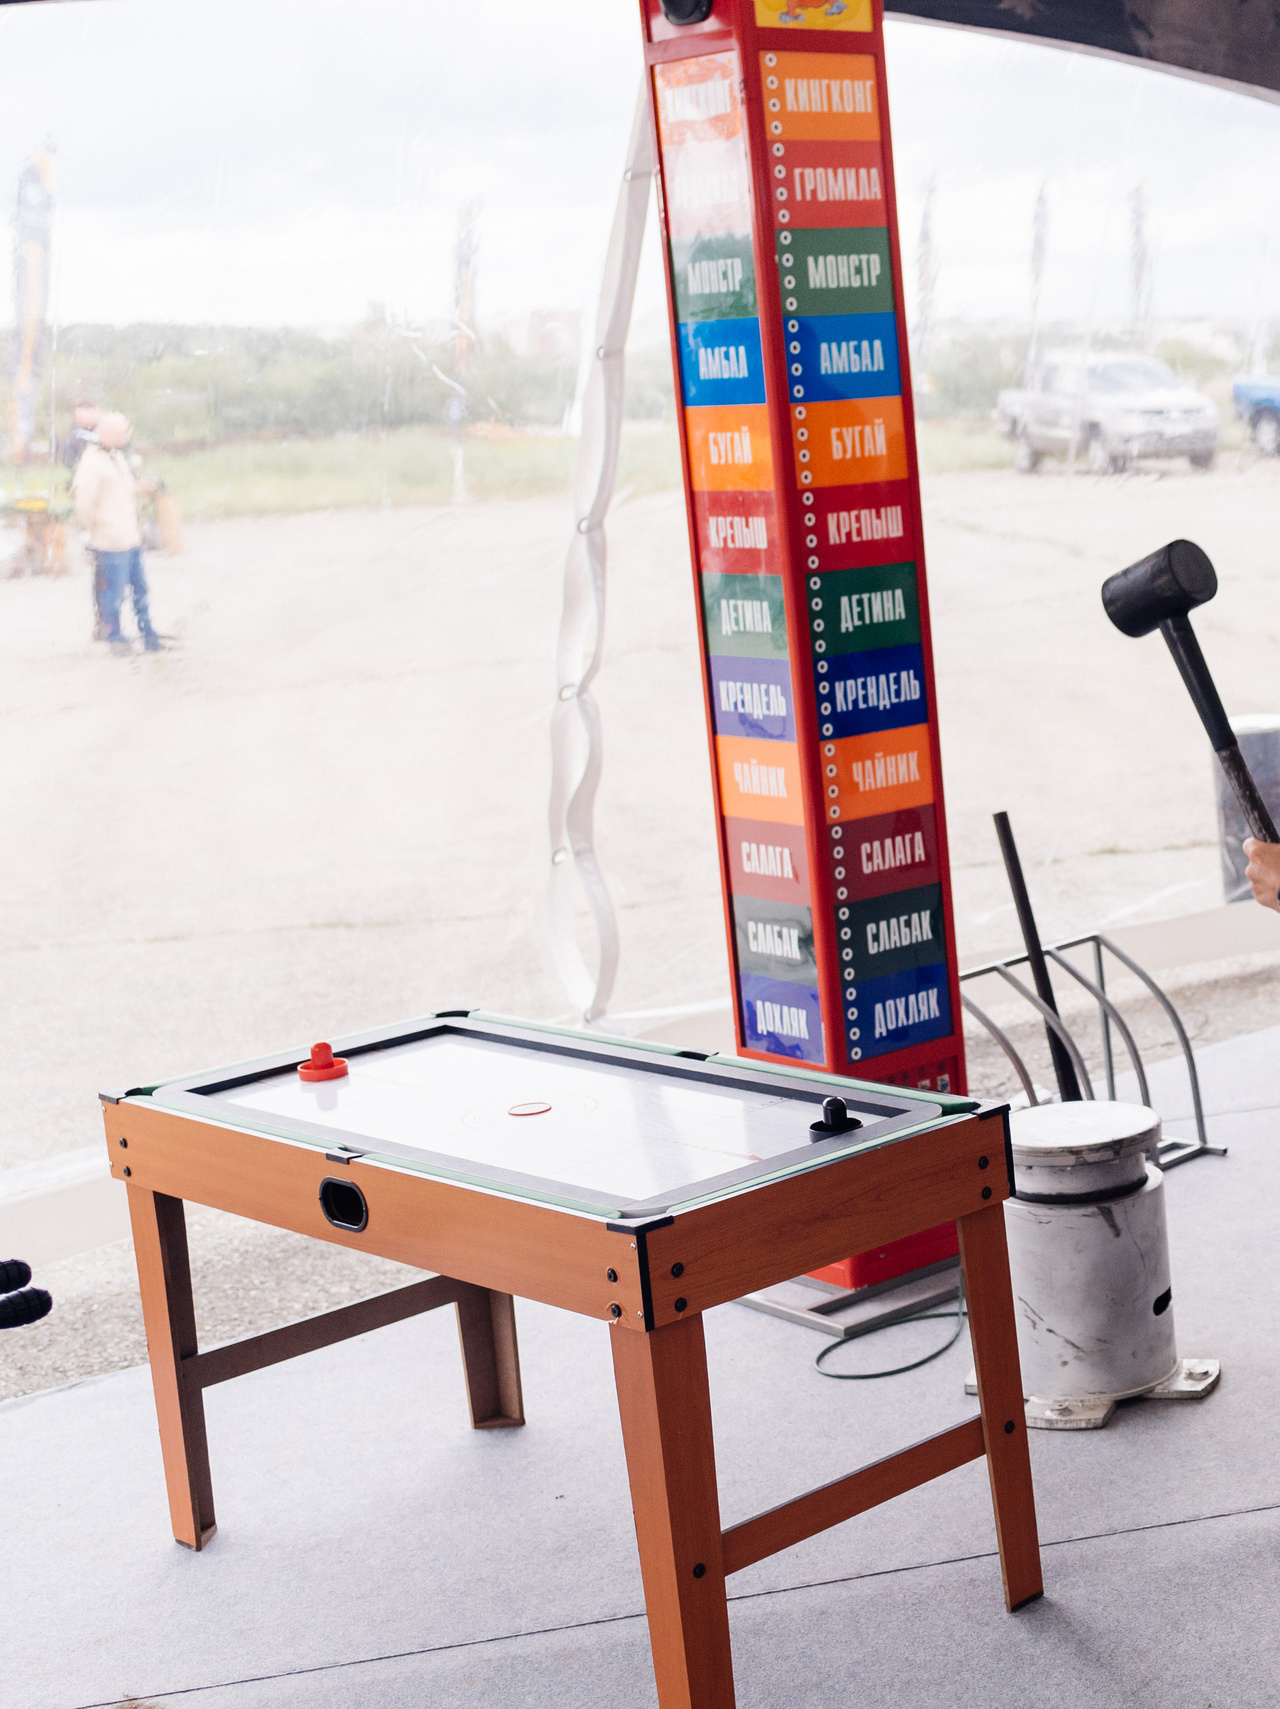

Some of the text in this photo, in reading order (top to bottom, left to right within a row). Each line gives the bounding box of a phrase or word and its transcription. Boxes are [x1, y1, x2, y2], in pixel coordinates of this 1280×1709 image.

[785, 78, 873, 113] КИНГКОНГ
[793, 168, 882, 201] ГРОМИЛА
[687, 258, 742, 295] МОНСТР
[807, 254, 881, 289] МОНСТР
[699, 345, 749, 380] АМБАЛ
[820, 340, 885, 374] АМБАЛ
[708, 426, 753, 465] БУГАЙ
[830, 418, 887, 460] БУГАЙ
[709, 516, 768, 549] КРЕПЫШ
[827, 506, 904, 545] КРЕПЫШ
[720, 599, 772, 635] ДЕТИНА
[840, 588, 906, 633] ДЕТИНА
[719, 680, 787, 720] КРЕНДЕЛЬ
[834, 670, 921, 712] КРЕНДЕЛЬ
[733, 758, 787, 798] ЧАЙНИК
[852, 751, 920, 792] ЧАЙНИК
[741, 841, 793, 879] САЛАГА
[861, 831, 926, 874] САЛАГА
[747, 920, 801, 960] СЛАБАК
[866, 910, 933, 955] СЛАБАК
[756, 999, 809, 1040] ДОХЛЯК
[874, 988, 940, 1039] ДОХЛЯК
